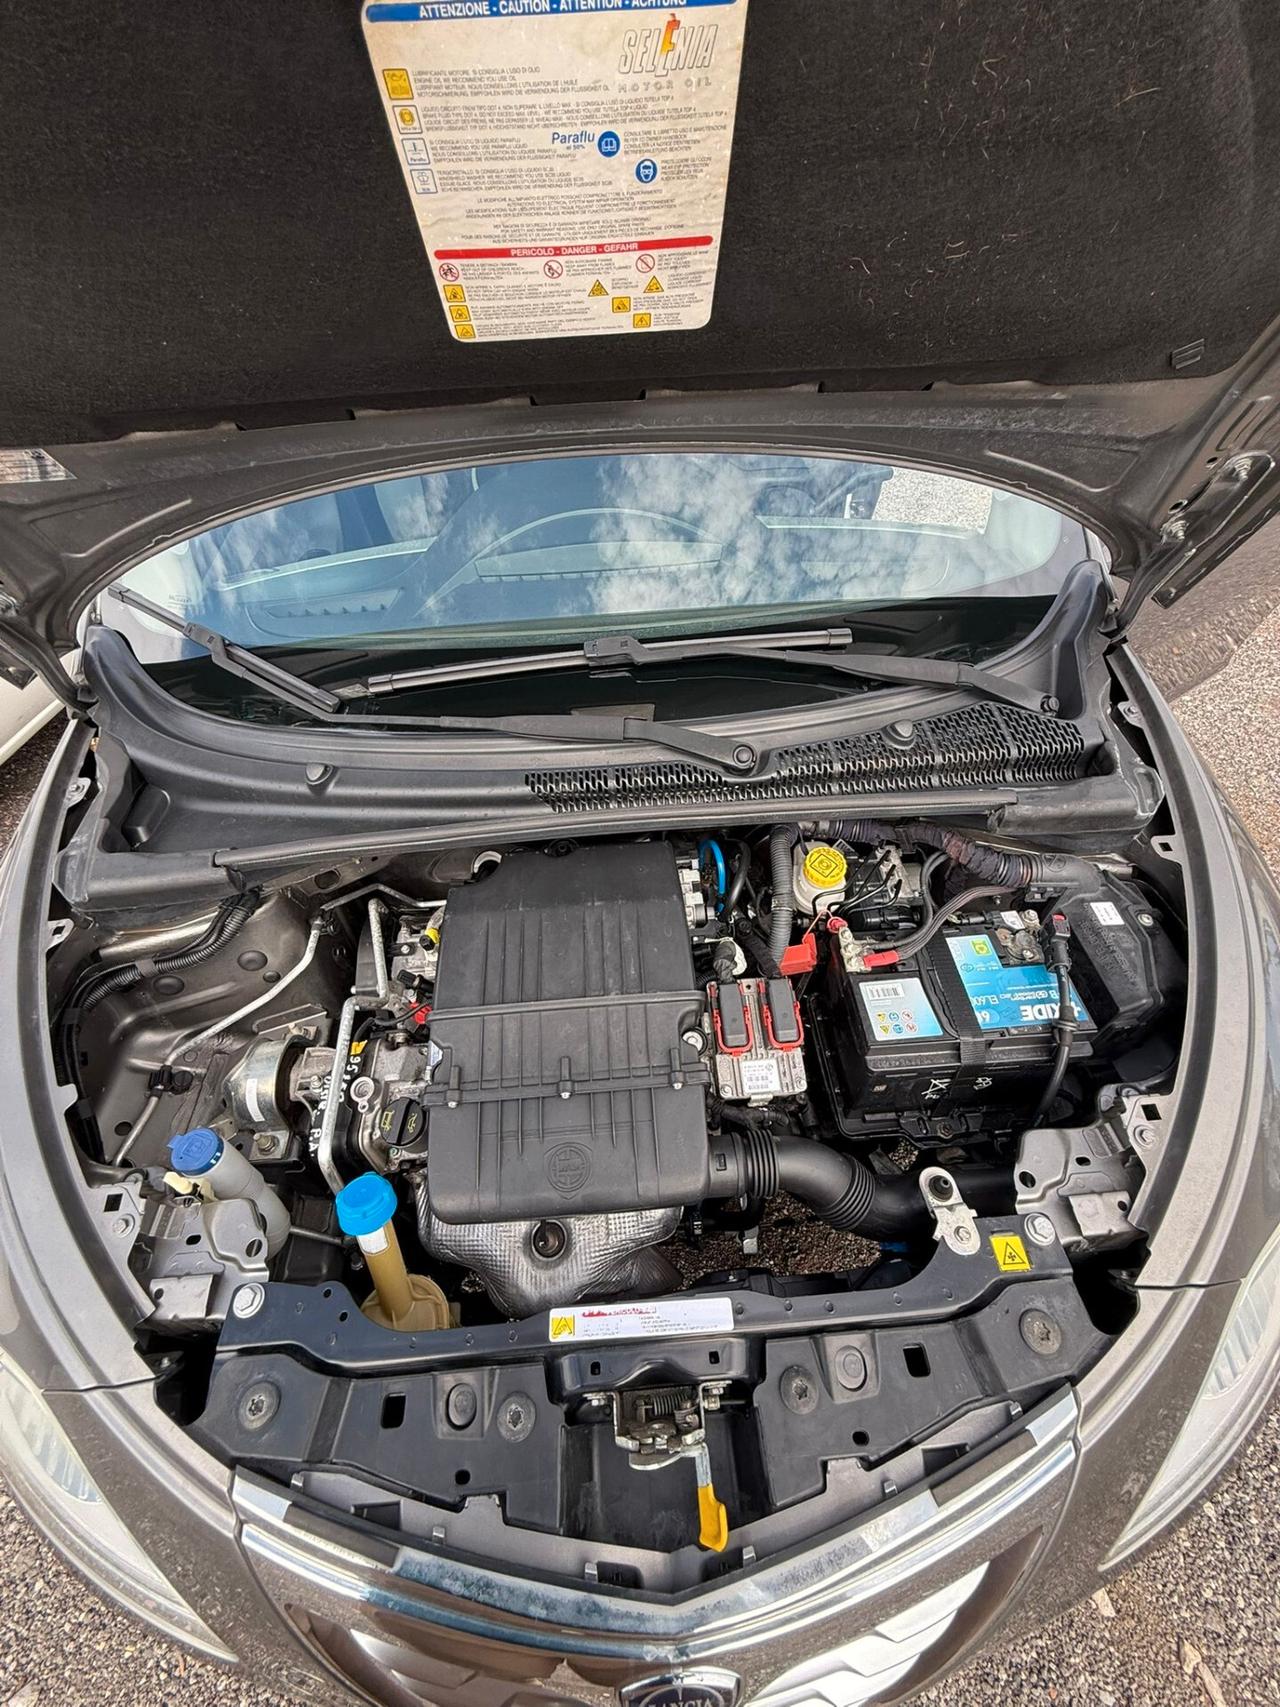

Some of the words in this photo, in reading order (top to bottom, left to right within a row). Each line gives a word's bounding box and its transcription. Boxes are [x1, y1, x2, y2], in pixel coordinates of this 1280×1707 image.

[419, 2, 491, 18] ATTENZIONE
[499, 0, 550, 14] CAUTION
[560, 0, 622, 11] ATTENTION
[618, 13, 719, 77] SELENIA
[552, 130, 595, 144] Paraflu
[510, 247, 554, 257] PERICOLO
[561, 245, 597, 255] DANGER
[604, 242, 639, 252] GEFAHR
[1019, 1002, 1081, 1021] XIDE
